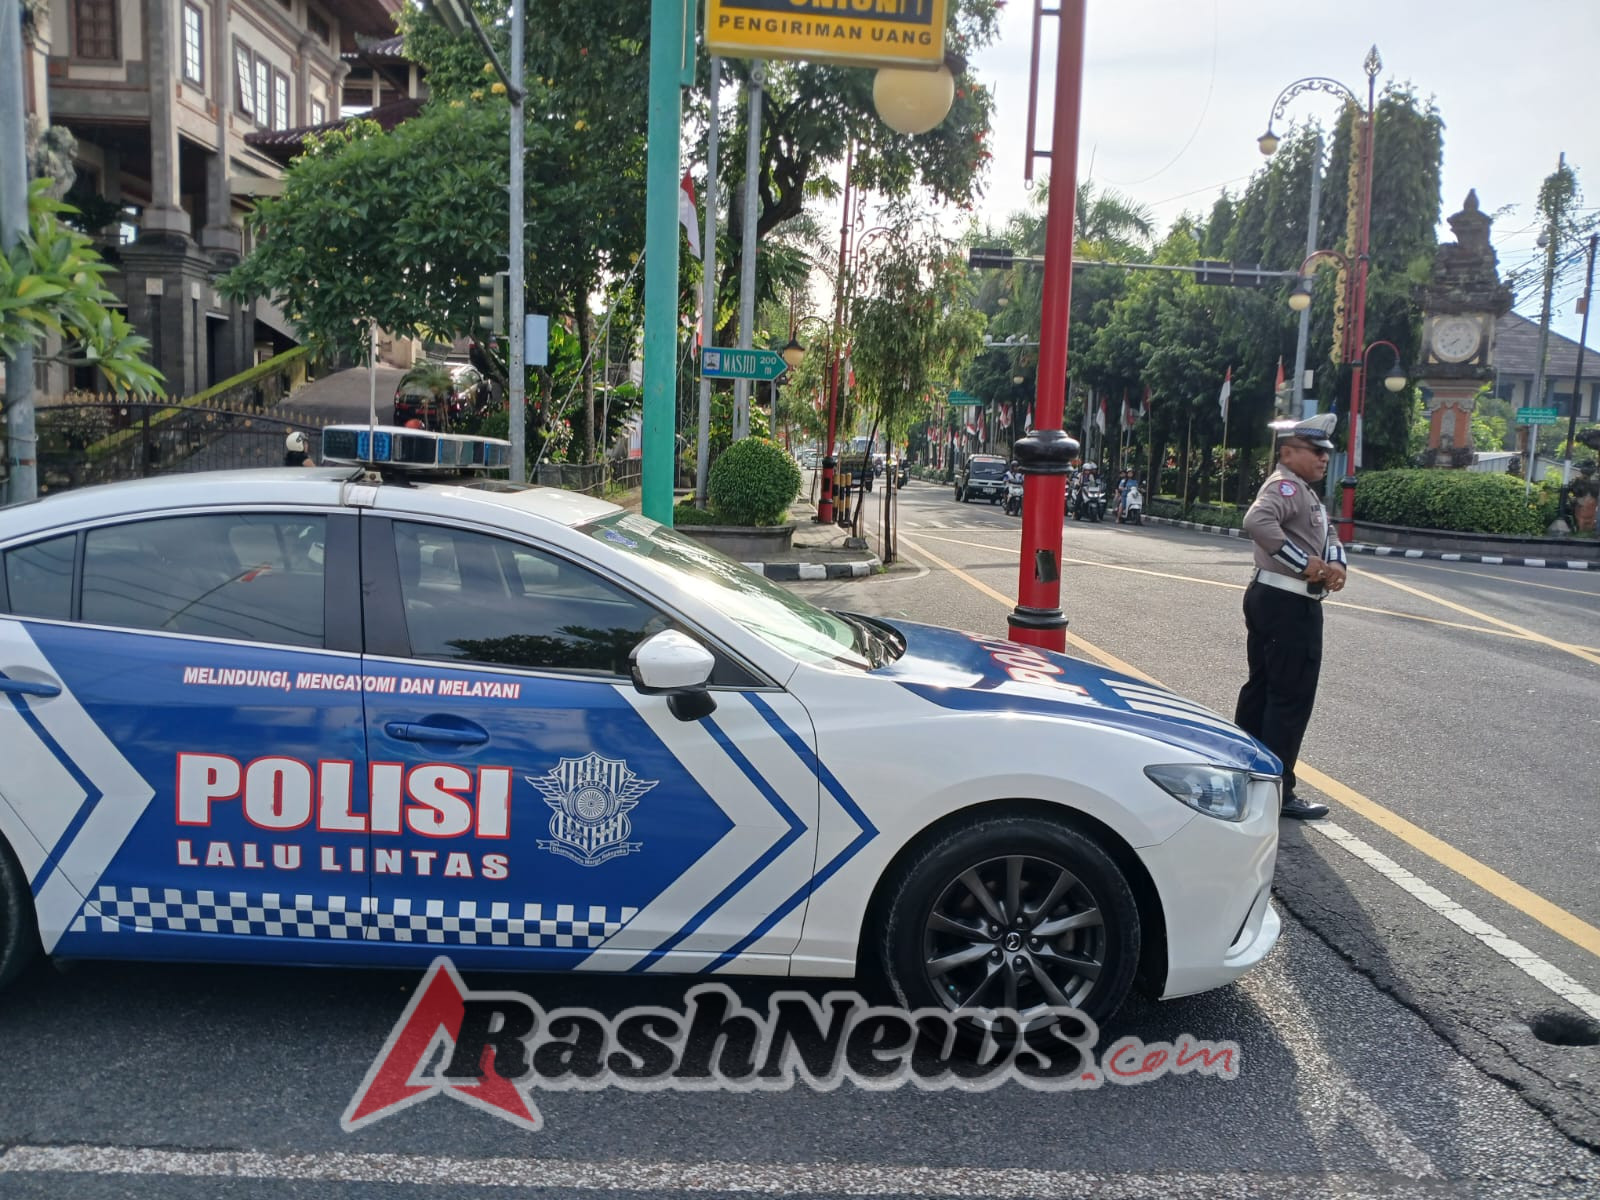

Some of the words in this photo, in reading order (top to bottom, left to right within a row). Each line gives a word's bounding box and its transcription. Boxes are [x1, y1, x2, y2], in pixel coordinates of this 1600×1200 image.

[718, 15, 862, 40] PENGIRIMAN
[871, 27, 932, 45] UANG
[723, 353, 756, 375] MASJID
[760, 356, 777, 365] 200
[183, 667, 291, 691] MELINDUNGI,
[296, 673, 397, 693] MENGAYOMI
[400, 677, 434, 695] DAN
[438, 680, 521, 698] MELAYANI
[175, 752, 513, 839] POLISI
[177, 840, 301, 870] LALU
[320, 846, 509, 880] LINTAS
